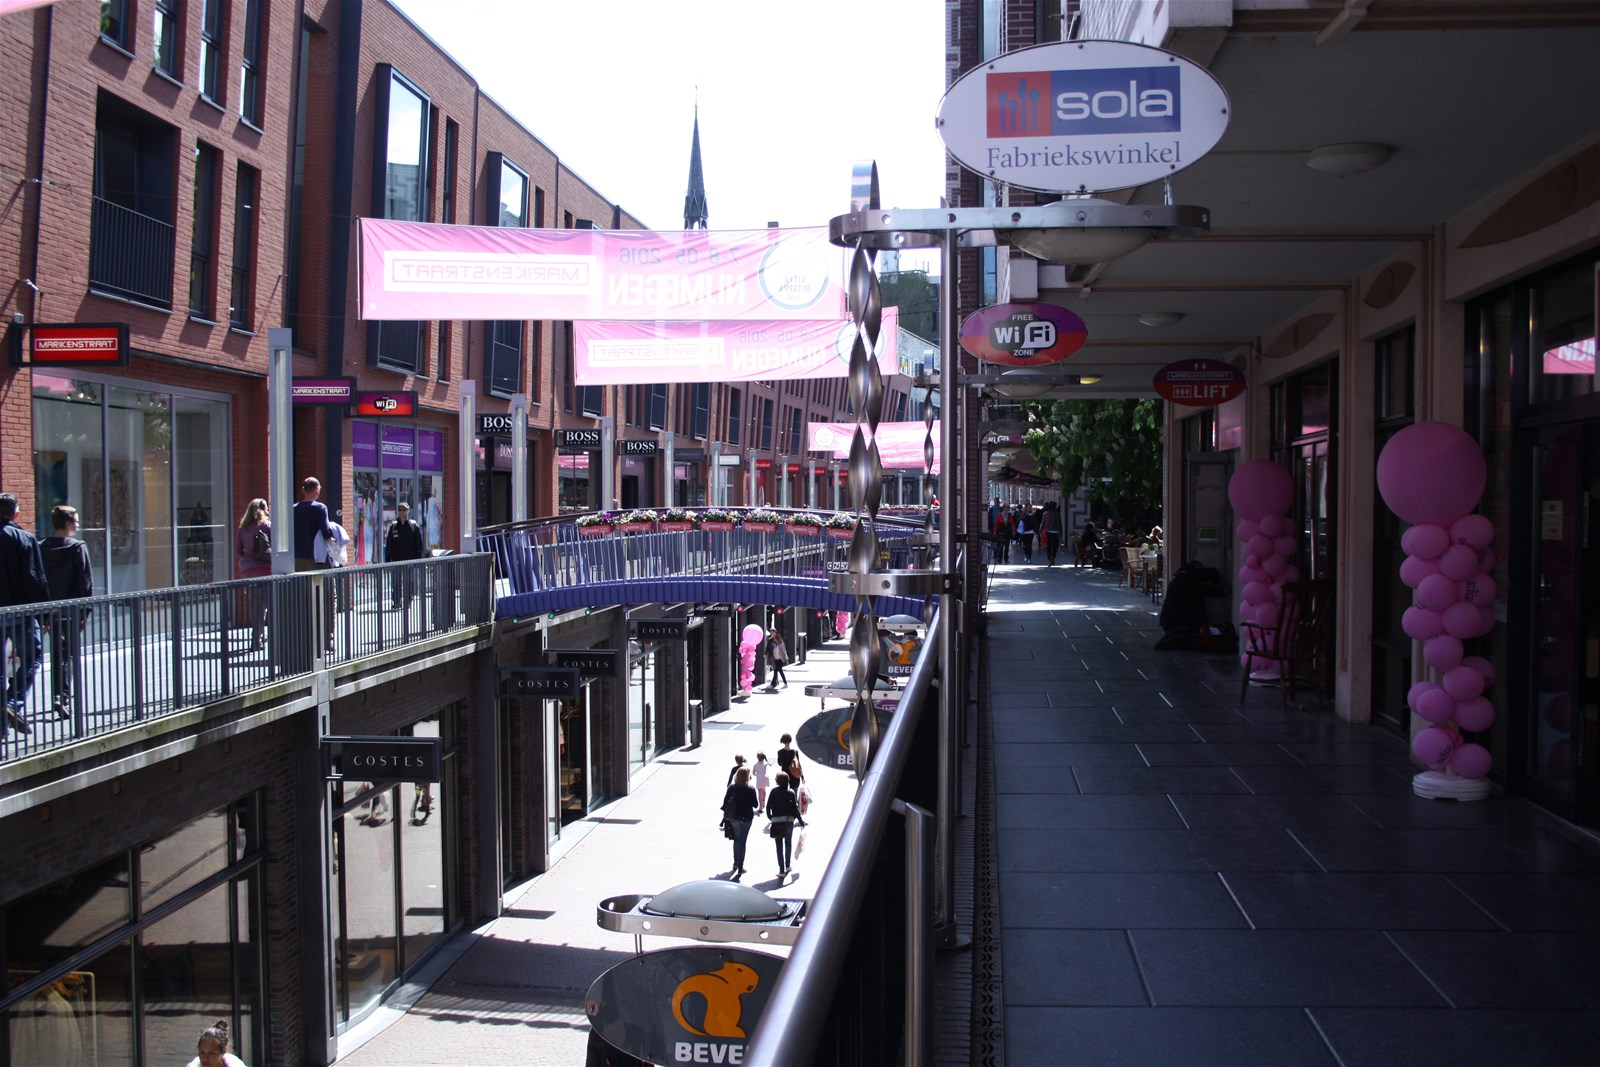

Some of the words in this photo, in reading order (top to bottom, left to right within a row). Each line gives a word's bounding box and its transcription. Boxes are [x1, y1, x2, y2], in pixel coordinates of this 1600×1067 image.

[1056, 80, 1173, 120] sola
[986, 141, 1182, 169] Fabriekswinkel
[1011, 313, 1035, 321] FREE
[38, 339, 115, 350] MARIKENSTRAAT
[1013, 349, 1035, 357] ZONE
[1193, 384, 1230, 399] LIFT
[483, 416, 513, 429] BOS
[566, 431, 599, 441] BOSS
[627, 441, 655, 451] BOSS
[641, 627, 680, 635] COSTES
[563, 660, 610, 669] COSTES
[518, 680, 570, 689] COSTES
[353, 755, 425, 768] COSTES
[675, 1041, 748, 1065] BEVE
